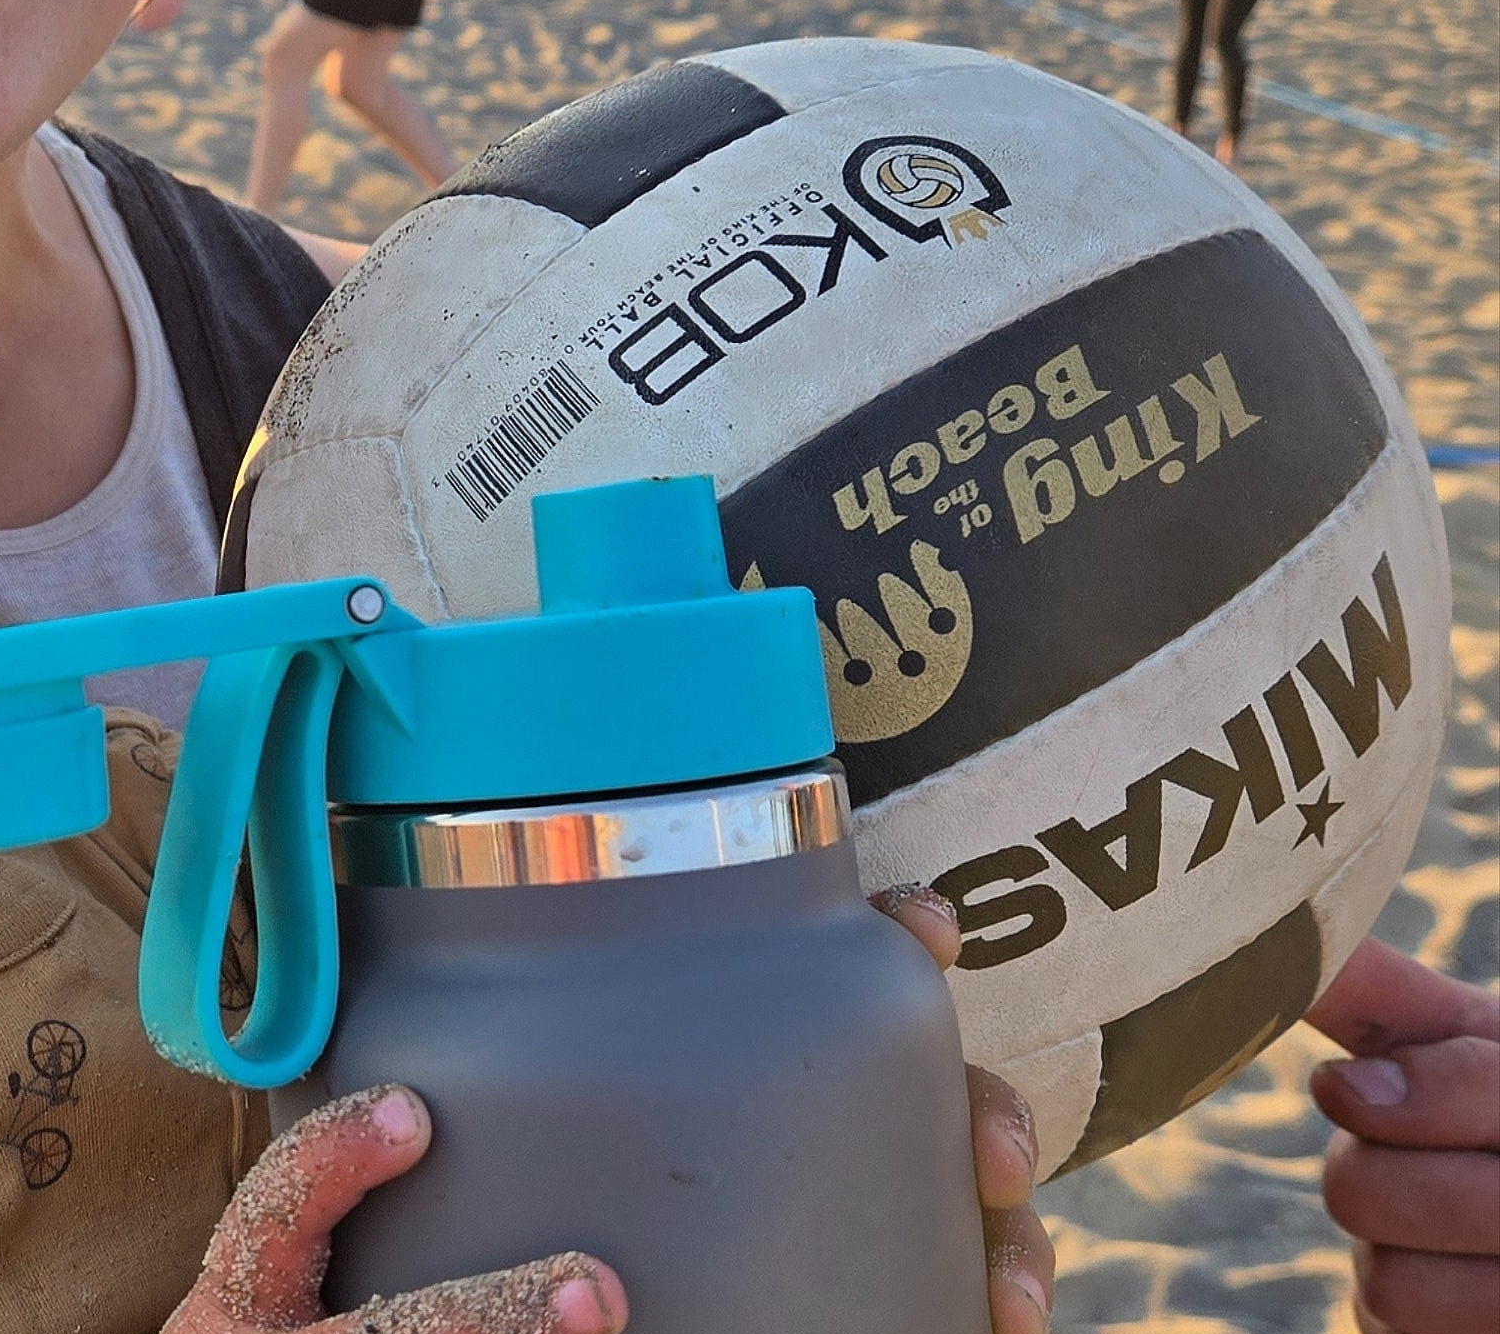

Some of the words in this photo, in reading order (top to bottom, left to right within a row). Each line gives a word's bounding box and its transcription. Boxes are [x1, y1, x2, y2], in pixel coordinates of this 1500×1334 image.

[759, 194, 789, 215] THE
[793, 182, 811, 196] OF
[675, 190, 824, 279] OFFICIAL
[700, 237, 718, 251] OF
[722, 214, 758, 236] KING
[667, 252, 696, 274] THE
[608, 203, 889, 406] KOB
[617, 273, 664, 311] BEACH
[578, 312, 616, 344] TOUR
[585, 290, 663, 351] BALL
[832, 343, 1112, 535] Beach
[1003, 351, 1263, 545] King
[933, 478, 980, 516] the
[928, 549, 1413, 971] MIKAS
